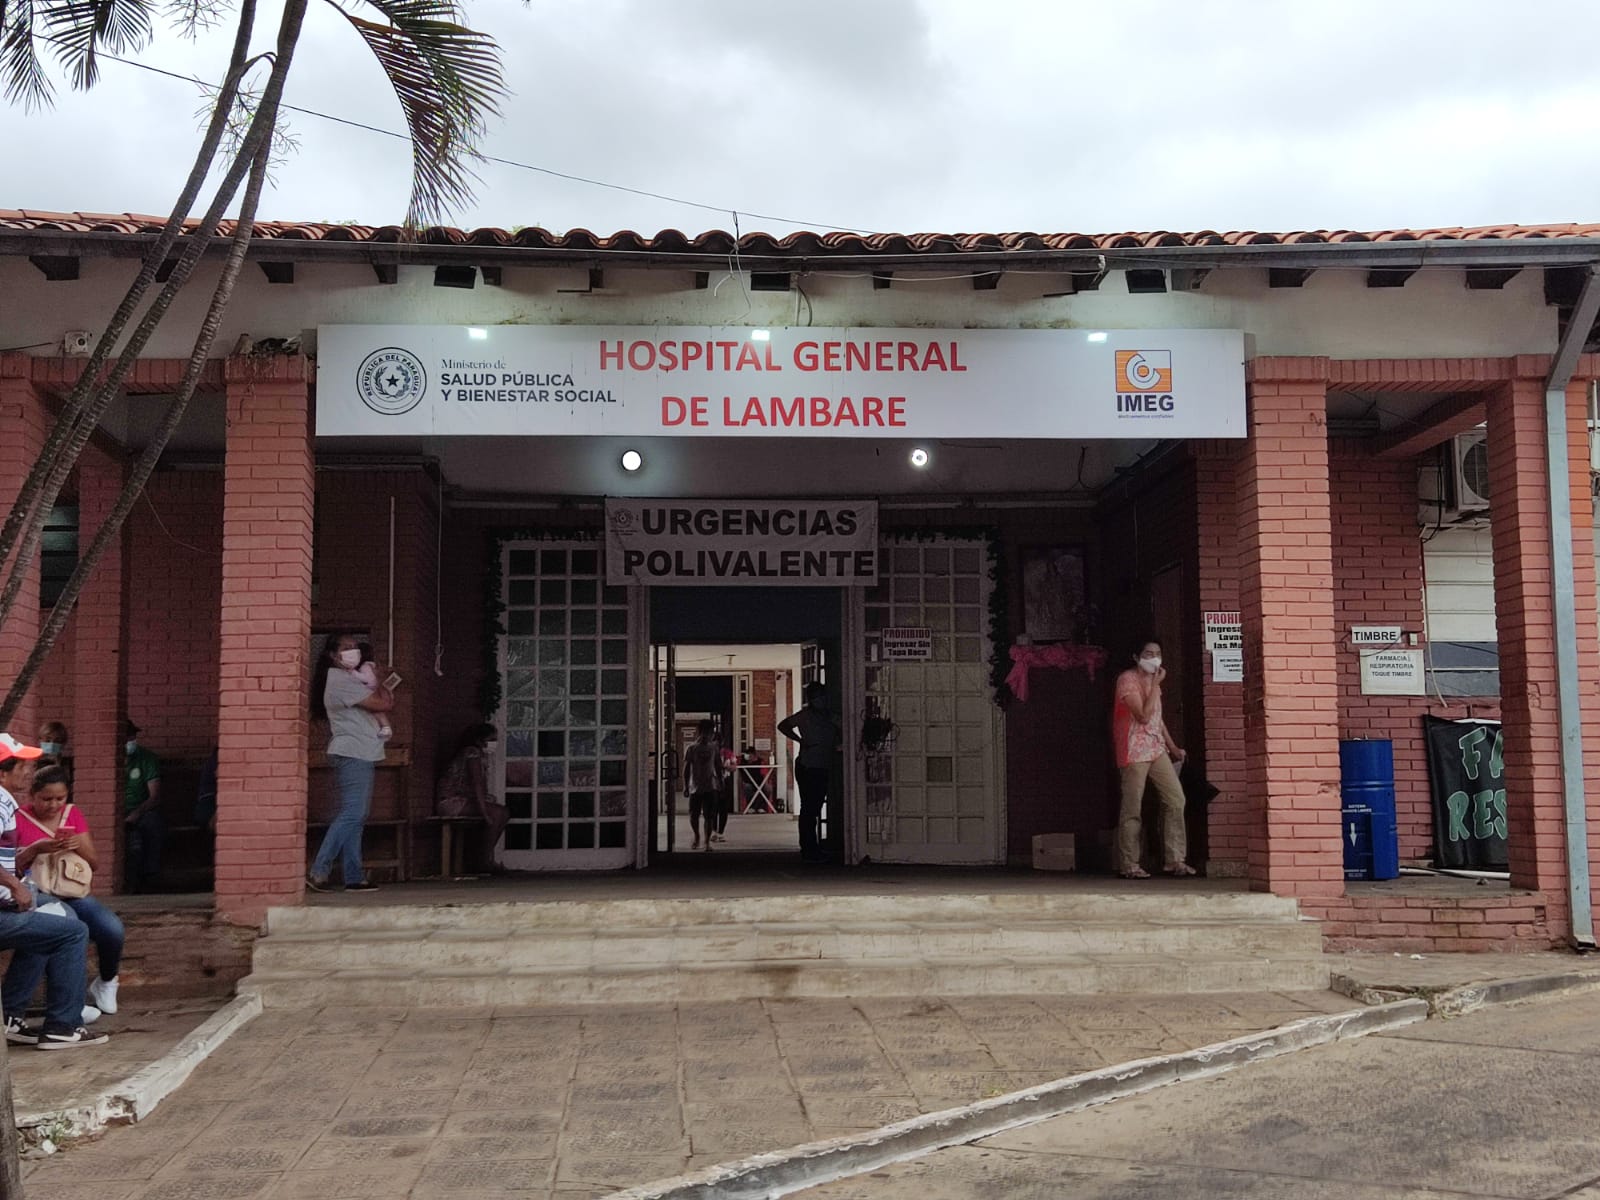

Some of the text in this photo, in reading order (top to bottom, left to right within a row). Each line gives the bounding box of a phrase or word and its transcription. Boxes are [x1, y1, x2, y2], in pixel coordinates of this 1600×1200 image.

[600, 340, 967, 372] HOSPITAL GENERAL
[441, 359, 506, 369] Ministerio de
[441, 370, 574, 387] SALUD PÚBLICA
[441, 389, 617, 402] Y BIENESTAR SOCIAL
[1117, 394, 1174, 412] IMEG
[661, 396, 907, 427] DE LAMBARE
[642, 508, 857, 536] URGENCIAS
[623, 550, 875, 577] POLIVALENTE
[1206, 613, 1241, 625] PROHI
[884, 629, 931, 639] PROHIBIDO
[1353, 631, 1397, 641] TIMBRE
[884, 640, 931, 648] Ingresar Sin
